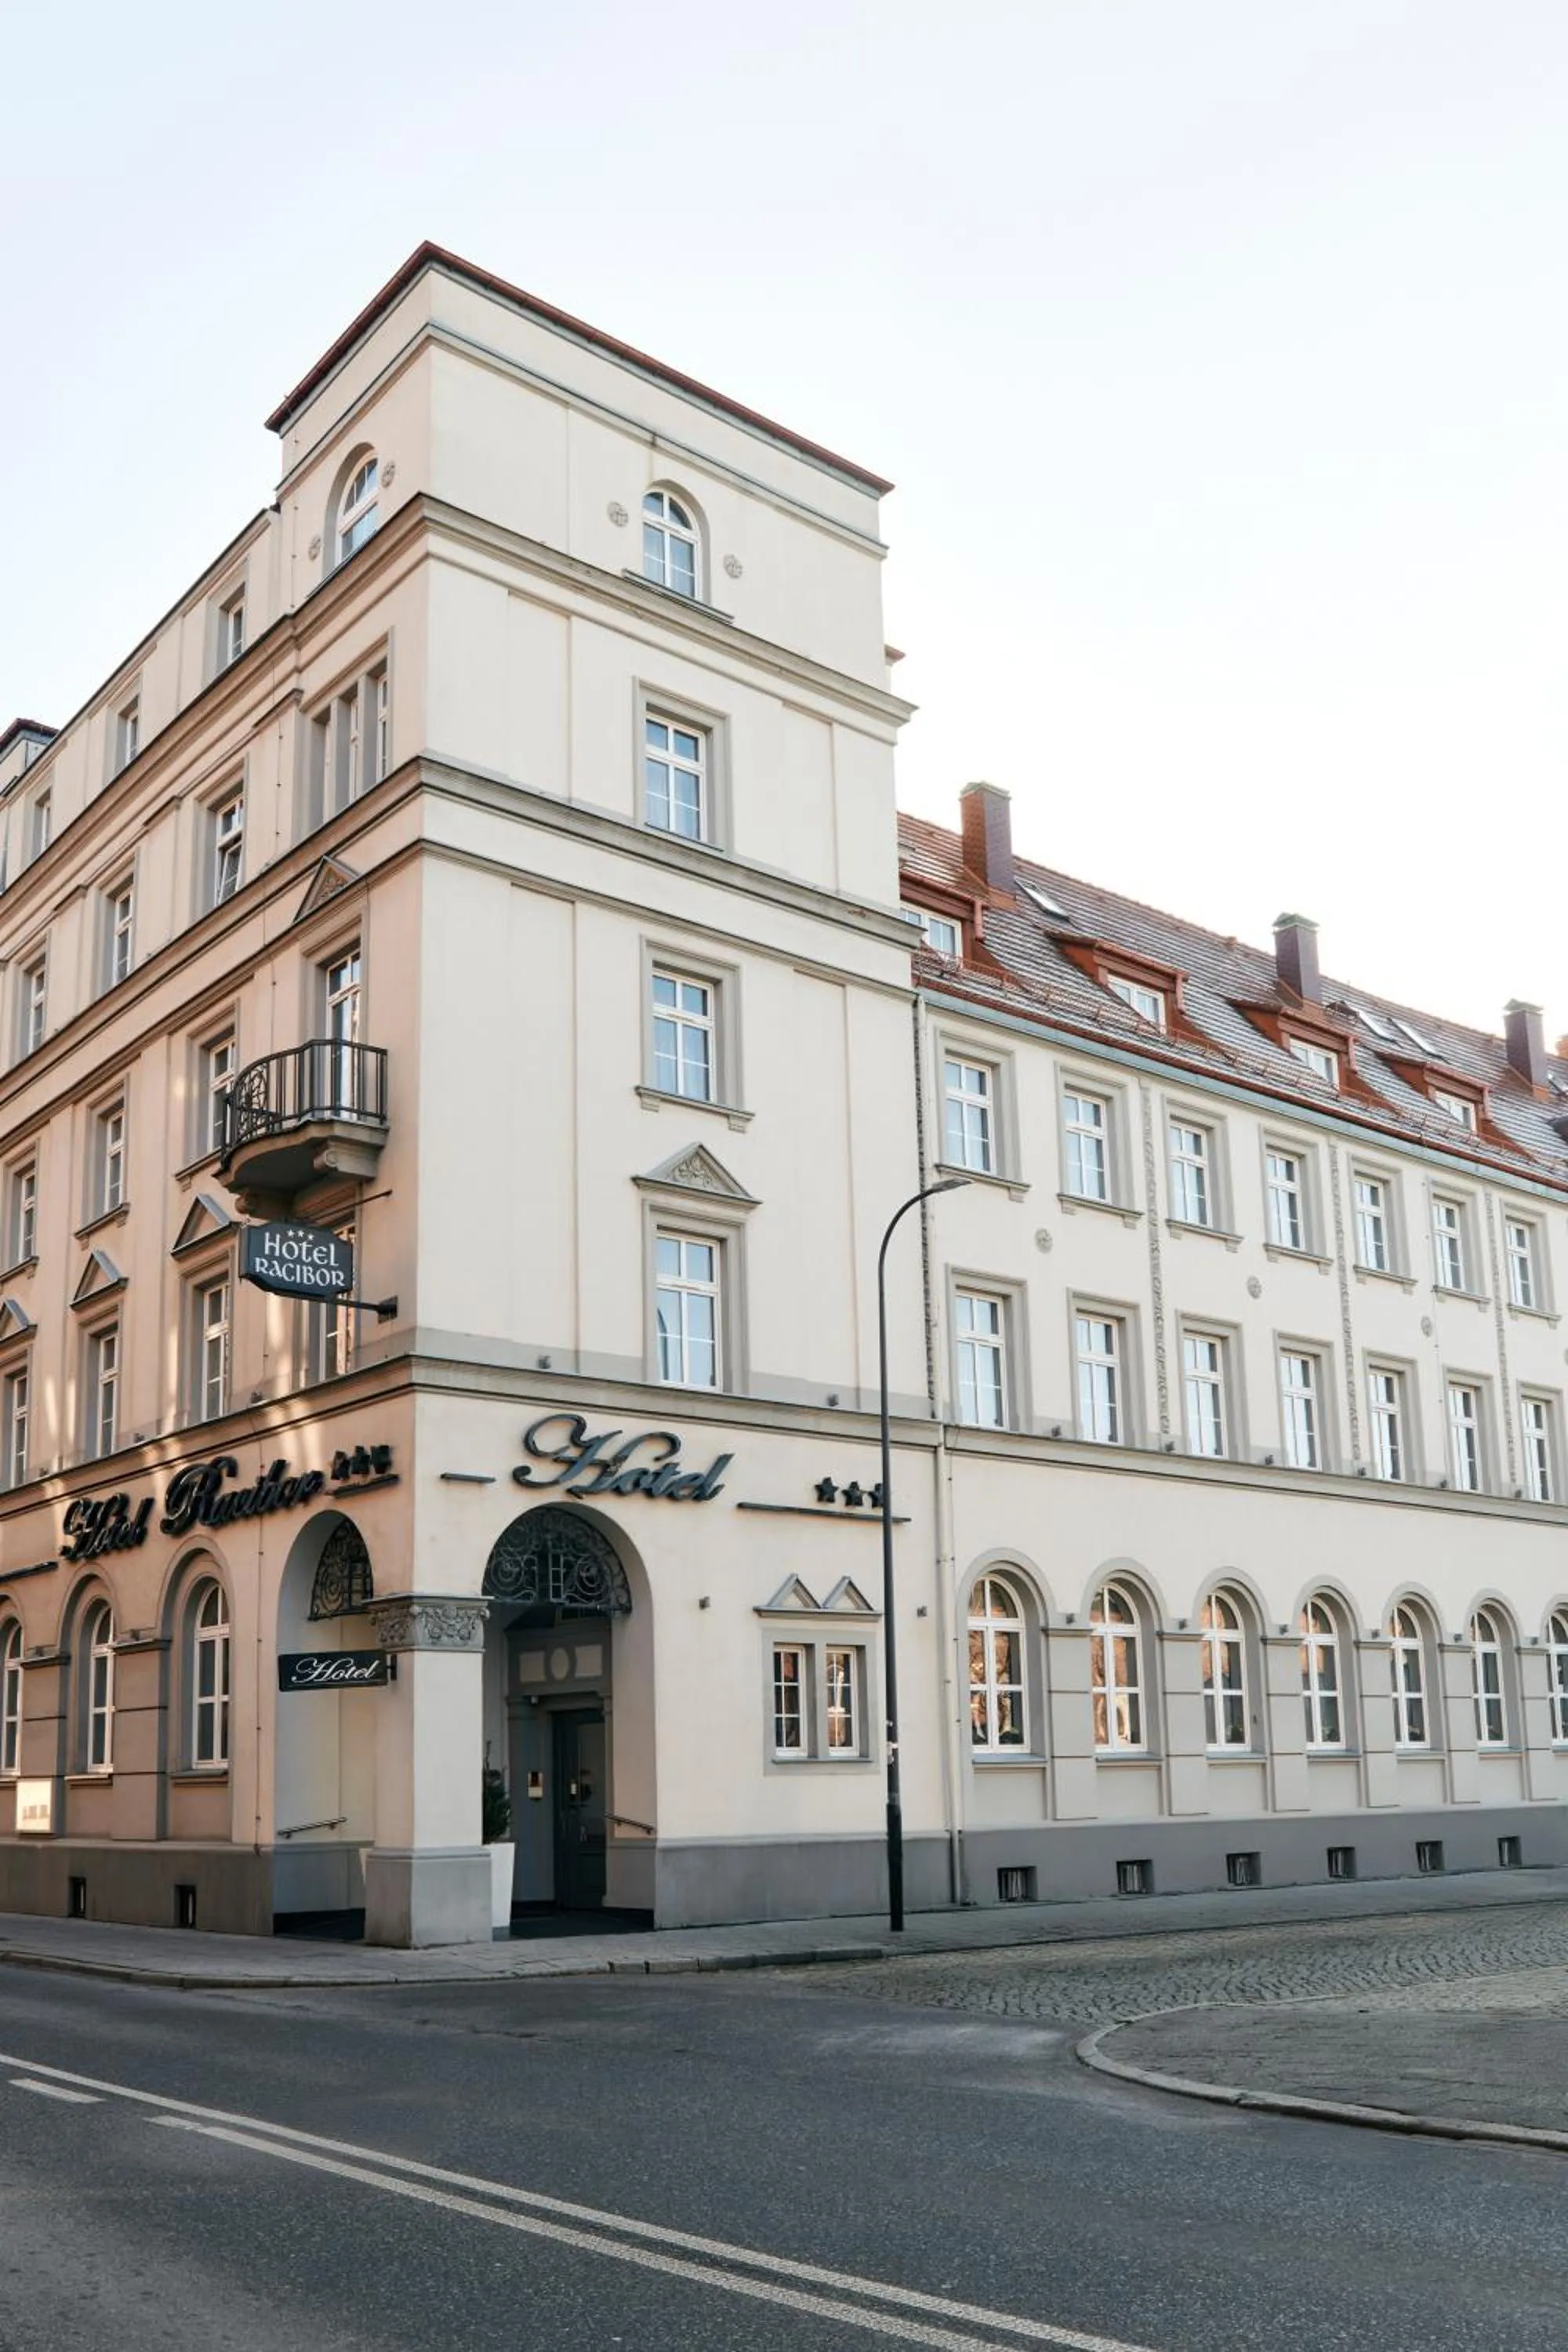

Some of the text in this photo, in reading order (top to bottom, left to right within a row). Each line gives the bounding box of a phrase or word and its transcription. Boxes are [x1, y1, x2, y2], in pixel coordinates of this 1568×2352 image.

[254, 1257, 345, 1287] RACIBOR
[512, 1413, 735, 1501] Hotel
[60, 1493, 154, 1562] Hotel
[291, 1657, 380, 1683] Hotel
